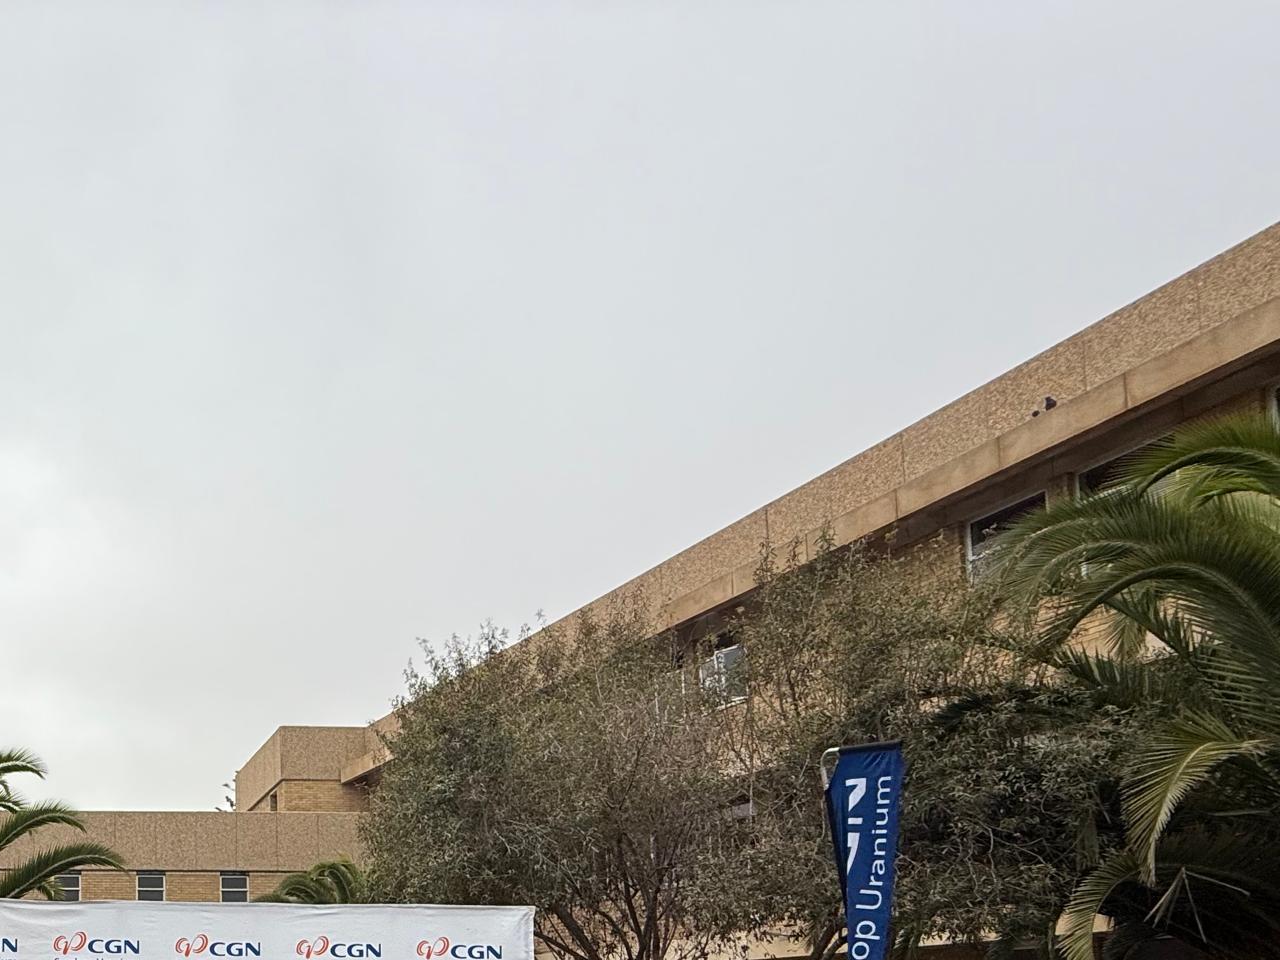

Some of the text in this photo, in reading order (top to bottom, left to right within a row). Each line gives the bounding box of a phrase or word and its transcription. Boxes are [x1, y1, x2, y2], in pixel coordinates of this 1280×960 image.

[856, 775, 892, 911] Uranium
[88, 939, 139, 954] CGN
[210, 942, 261, 957] CGN
[330, 943, 381, 958] CGN
[451, 944, 502, 959] CGN
